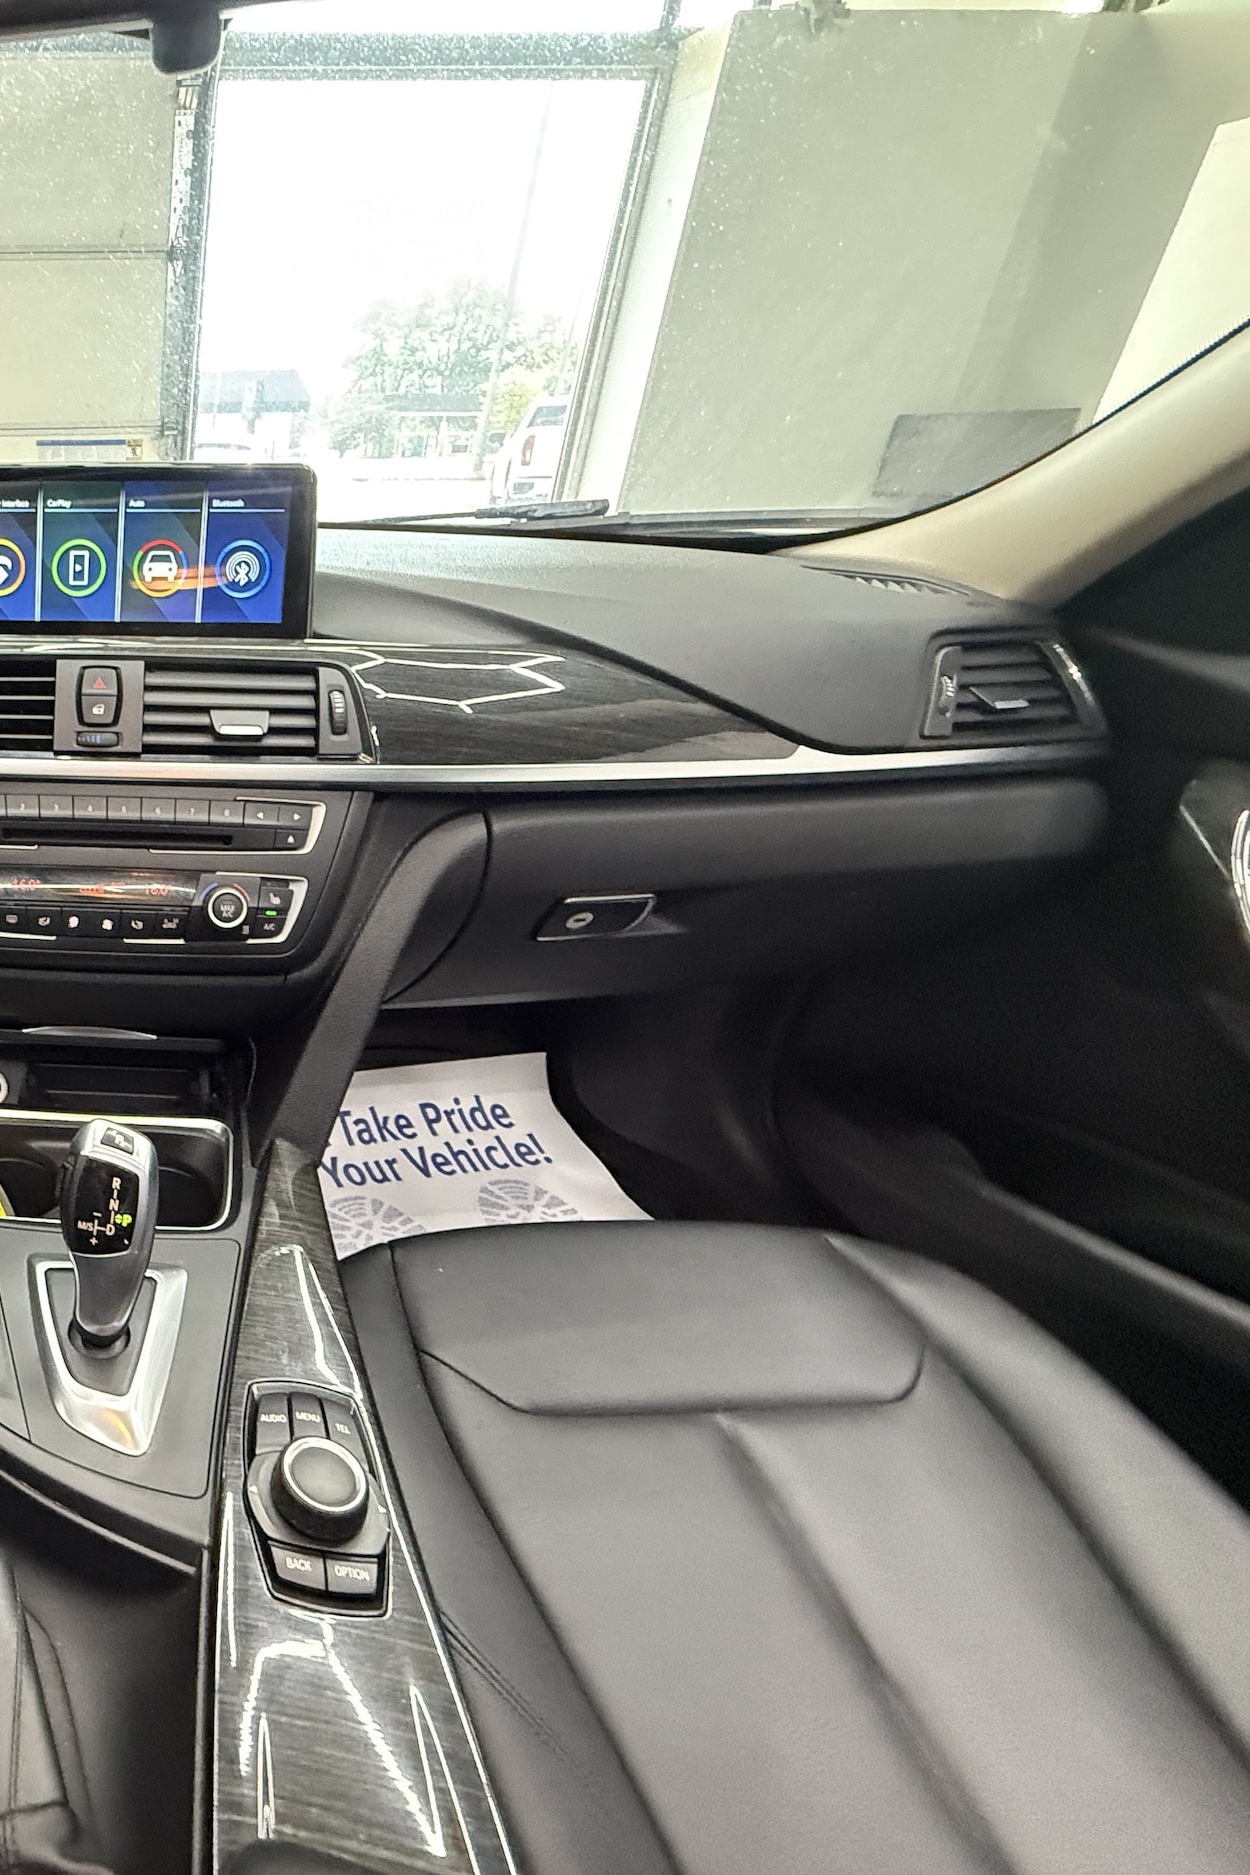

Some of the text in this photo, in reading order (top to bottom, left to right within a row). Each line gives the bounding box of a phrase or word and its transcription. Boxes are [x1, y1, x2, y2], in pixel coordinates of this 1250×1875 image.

[263, 923, 276, 931] A/C
[339, 1095, 515, 1147] Take Pride
[321, 1133, 553, 1188] Your Vehicle!
[112, 1177, 121, 1190] R
[109, 1199, 119, 1211] N
[77, 1220, 94, 1232] M/S
[122, 1214, 132, 1227] P
[105, 1224, 115, 1236] D
[260, 1413, 287, 1423] AUDIO
[295, 1412, 321, 1423] MENU
[335, 1423, 351, 1434] TEL
[286, 1558, 312, 1572] BACK
[334, 1565, 371, 1581] OPTION
